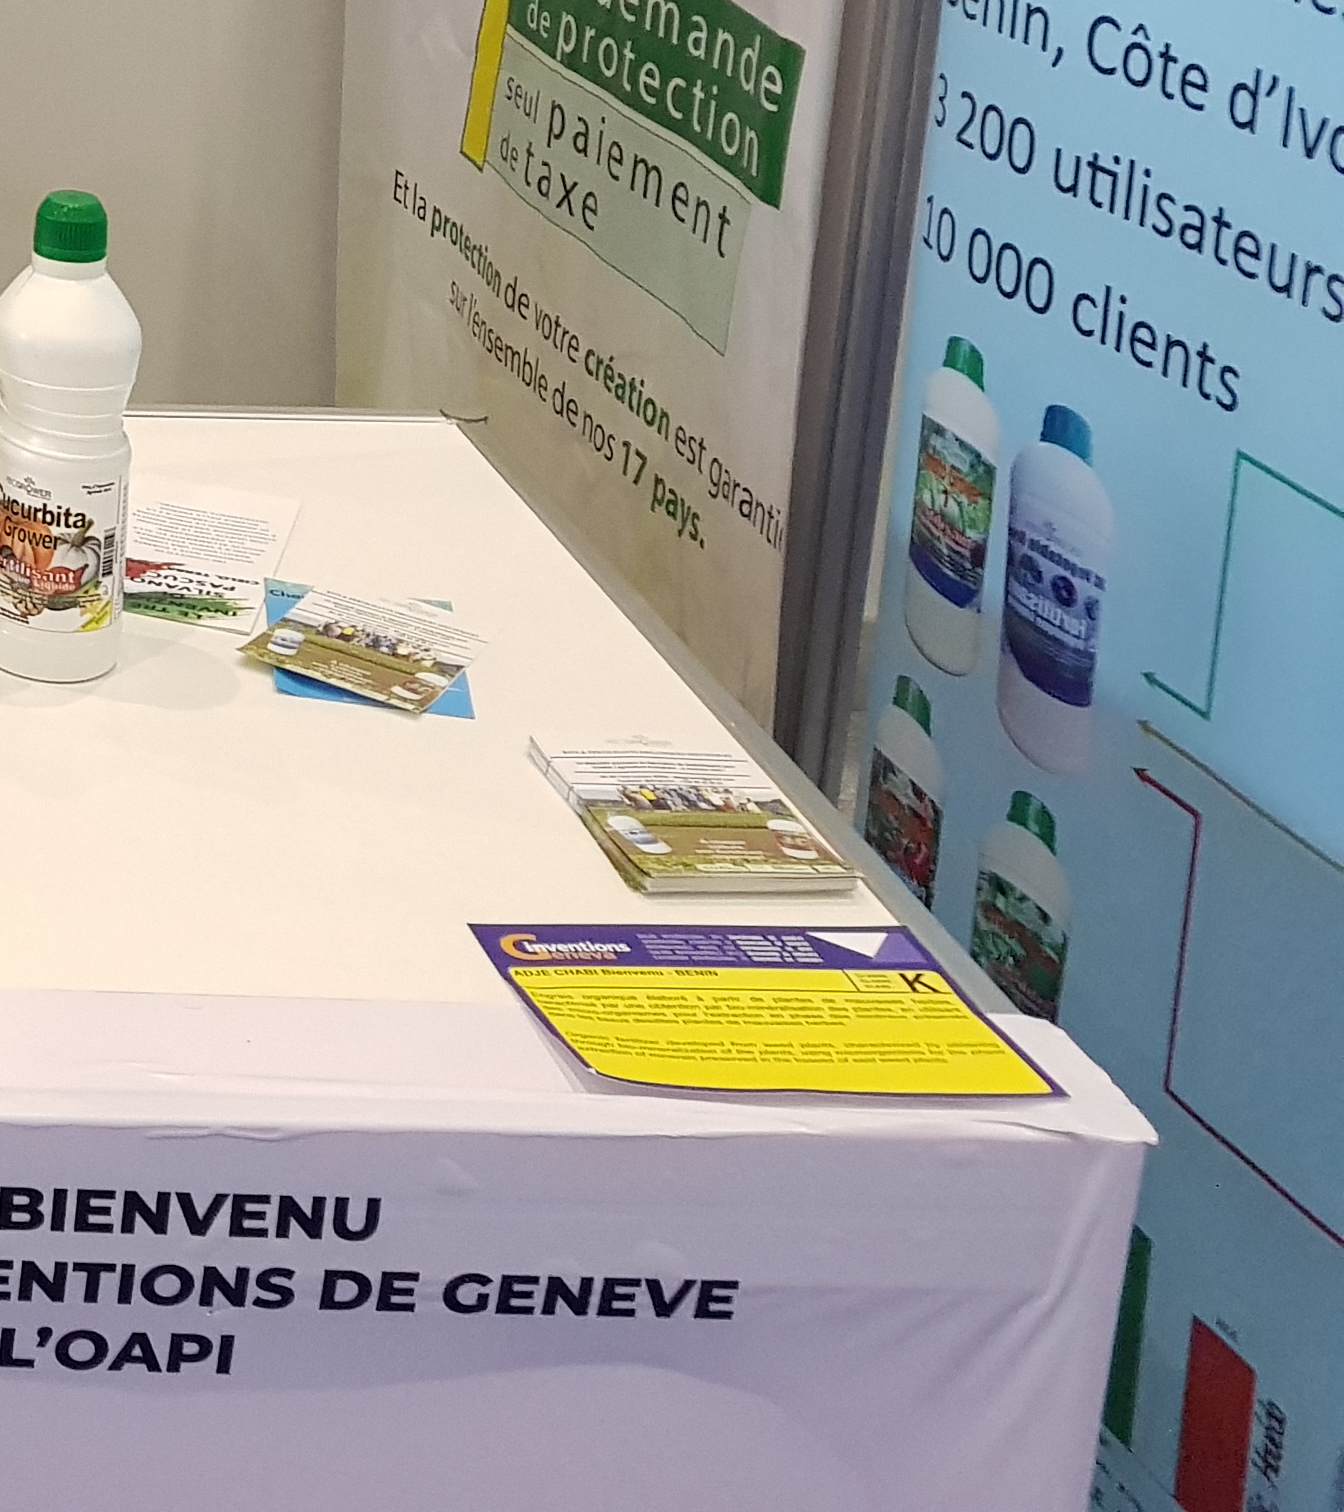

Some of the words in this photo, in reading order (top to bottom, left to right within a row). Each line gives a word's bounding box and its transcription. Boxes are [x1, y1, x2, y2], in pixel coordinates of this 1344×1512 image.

[556, 9, 760, 177] protection
[1087, 15, 1209, 112] Côte
[499, 132, 519, 164] de
[523, 140, 599, 231] taxe
[505, 73, 539, 125] seul
[547, 97, 730, 259] paiement
[934, 71, 950, 128] 3
[956, 91, 1036, 175] 200
[1053, 147, 1344, 325] utilisateurs
[392, 169, 411, 210] Et
[413, 189, 426, 221] la
[430, 204, 501, 297] protection
[504, 277, 530, 321] de
[534, 304, 580, 364] votre
[584, 347, 671, 442] création
[674, 425, 706, 475] est
[708, 456, 784, 553] garanti
[921, 194, 956, 263] 10
[968, 228, 1055, 315] 000
[1071, 285, 1241, 413] clients
[449, 278, 468, 316] sur
[552, 384, 579, 429] de
[583, 411, 616, 461] nos
[621, 439, 648, 486] 17
[650, 471, 706, 549] pays.
[4, 516, 59, 550] Grower
[514, 969, 550, 977] ADJE
[554, 969, 598, 977] CHABI
[898, 973, 944, 993] K
[319, 1269, 420, 1313] DE
[442, 1272, 739, 1321] GENEVE
